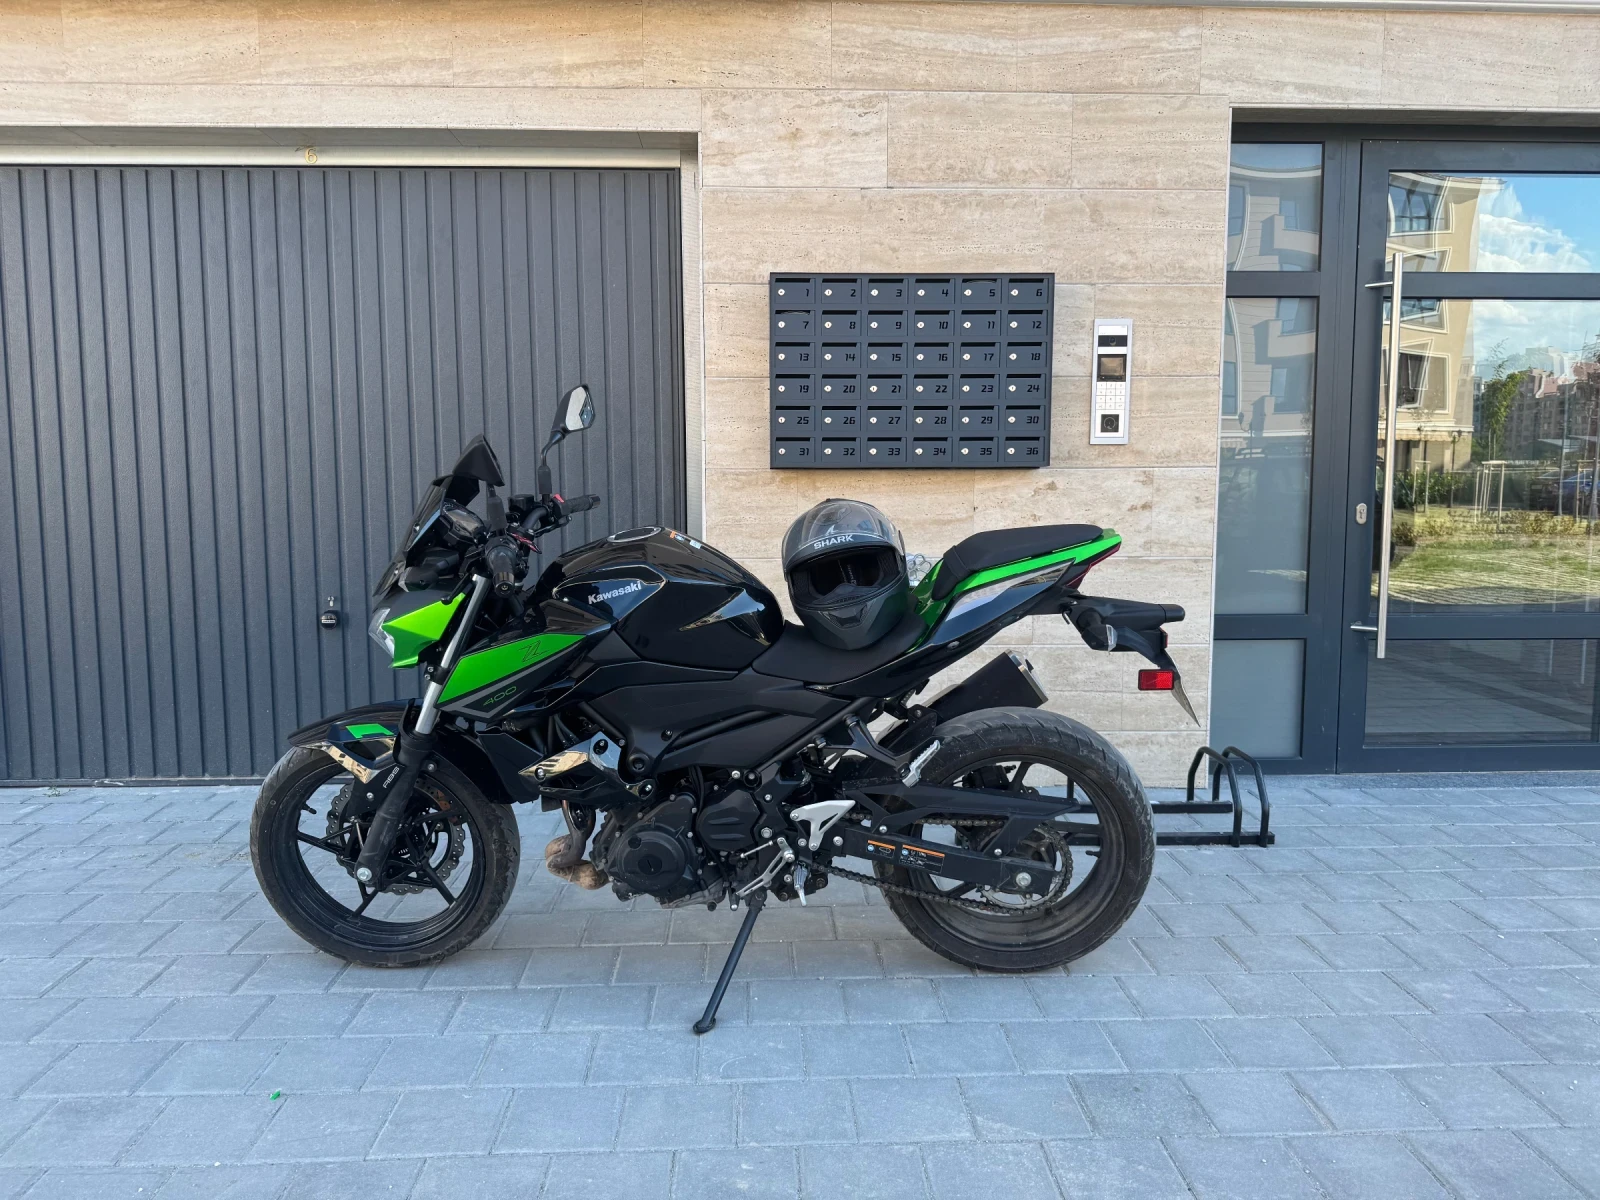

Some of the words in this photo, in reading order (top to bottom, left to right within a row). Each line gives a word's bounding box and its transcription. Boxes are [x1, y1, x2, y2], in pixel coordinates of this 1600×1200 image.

[304, 147, 318, 164] 6
[806, 288, 810, 296] 1
[850, 288, 856, 298] 2
[896, 288, 902, 298] 3
[942, 288, 948, 298] 4
[990, 288, 996, 296] 5
[1036, 288, 1042, 296] 6
[802, 320, 810, 330] 7
[850, 322, 856, 330] 8
[896, 322, 902, 330] 9
[938, 322, 948, 330] 10
[988, 320, 996, 330] 11
[1032, 320, 1042, 328] 12
[800, 354, 810, 362] 13
[846, 354, 856, 362] 14
[892, 354, 902, 362] 15
[938, 354, 948, 362] 16
[984, 352, 994, 362] 17
[1030, 352, 1040, 360] 18
[800, 384, 810, 394] 19
[842, 384, 856, 394] 20
[892, 384, 902, 394] 21
[934, 384, 948, 394] 22
[980, 384, 994, 392] 23
[1026, 384, 1040, 392] 24
[796, 416, 810, 424] 25
[842, 416, 856, 424] 26
[888, 416, 900, 424] 27
[934, 416, 946, 424] 28
[980, 416, 992, 424] 29
[1026, 416, 1040, 424] 30
[798, 448, 810, 456] 31
[842, 448, 856, 456] 32
[888, 448, 900, 456] 33
[932, 448, 946, 456] 34
[980, 448, 992, 456] 35
[1026, 448, 1038, 456] 36
[814, 534, 854, 550] SHARK
[588, 580, 642, 604] Kawasaki
[483, 686, 516, 706] 400
[382, 766, 400, 788] ABS
